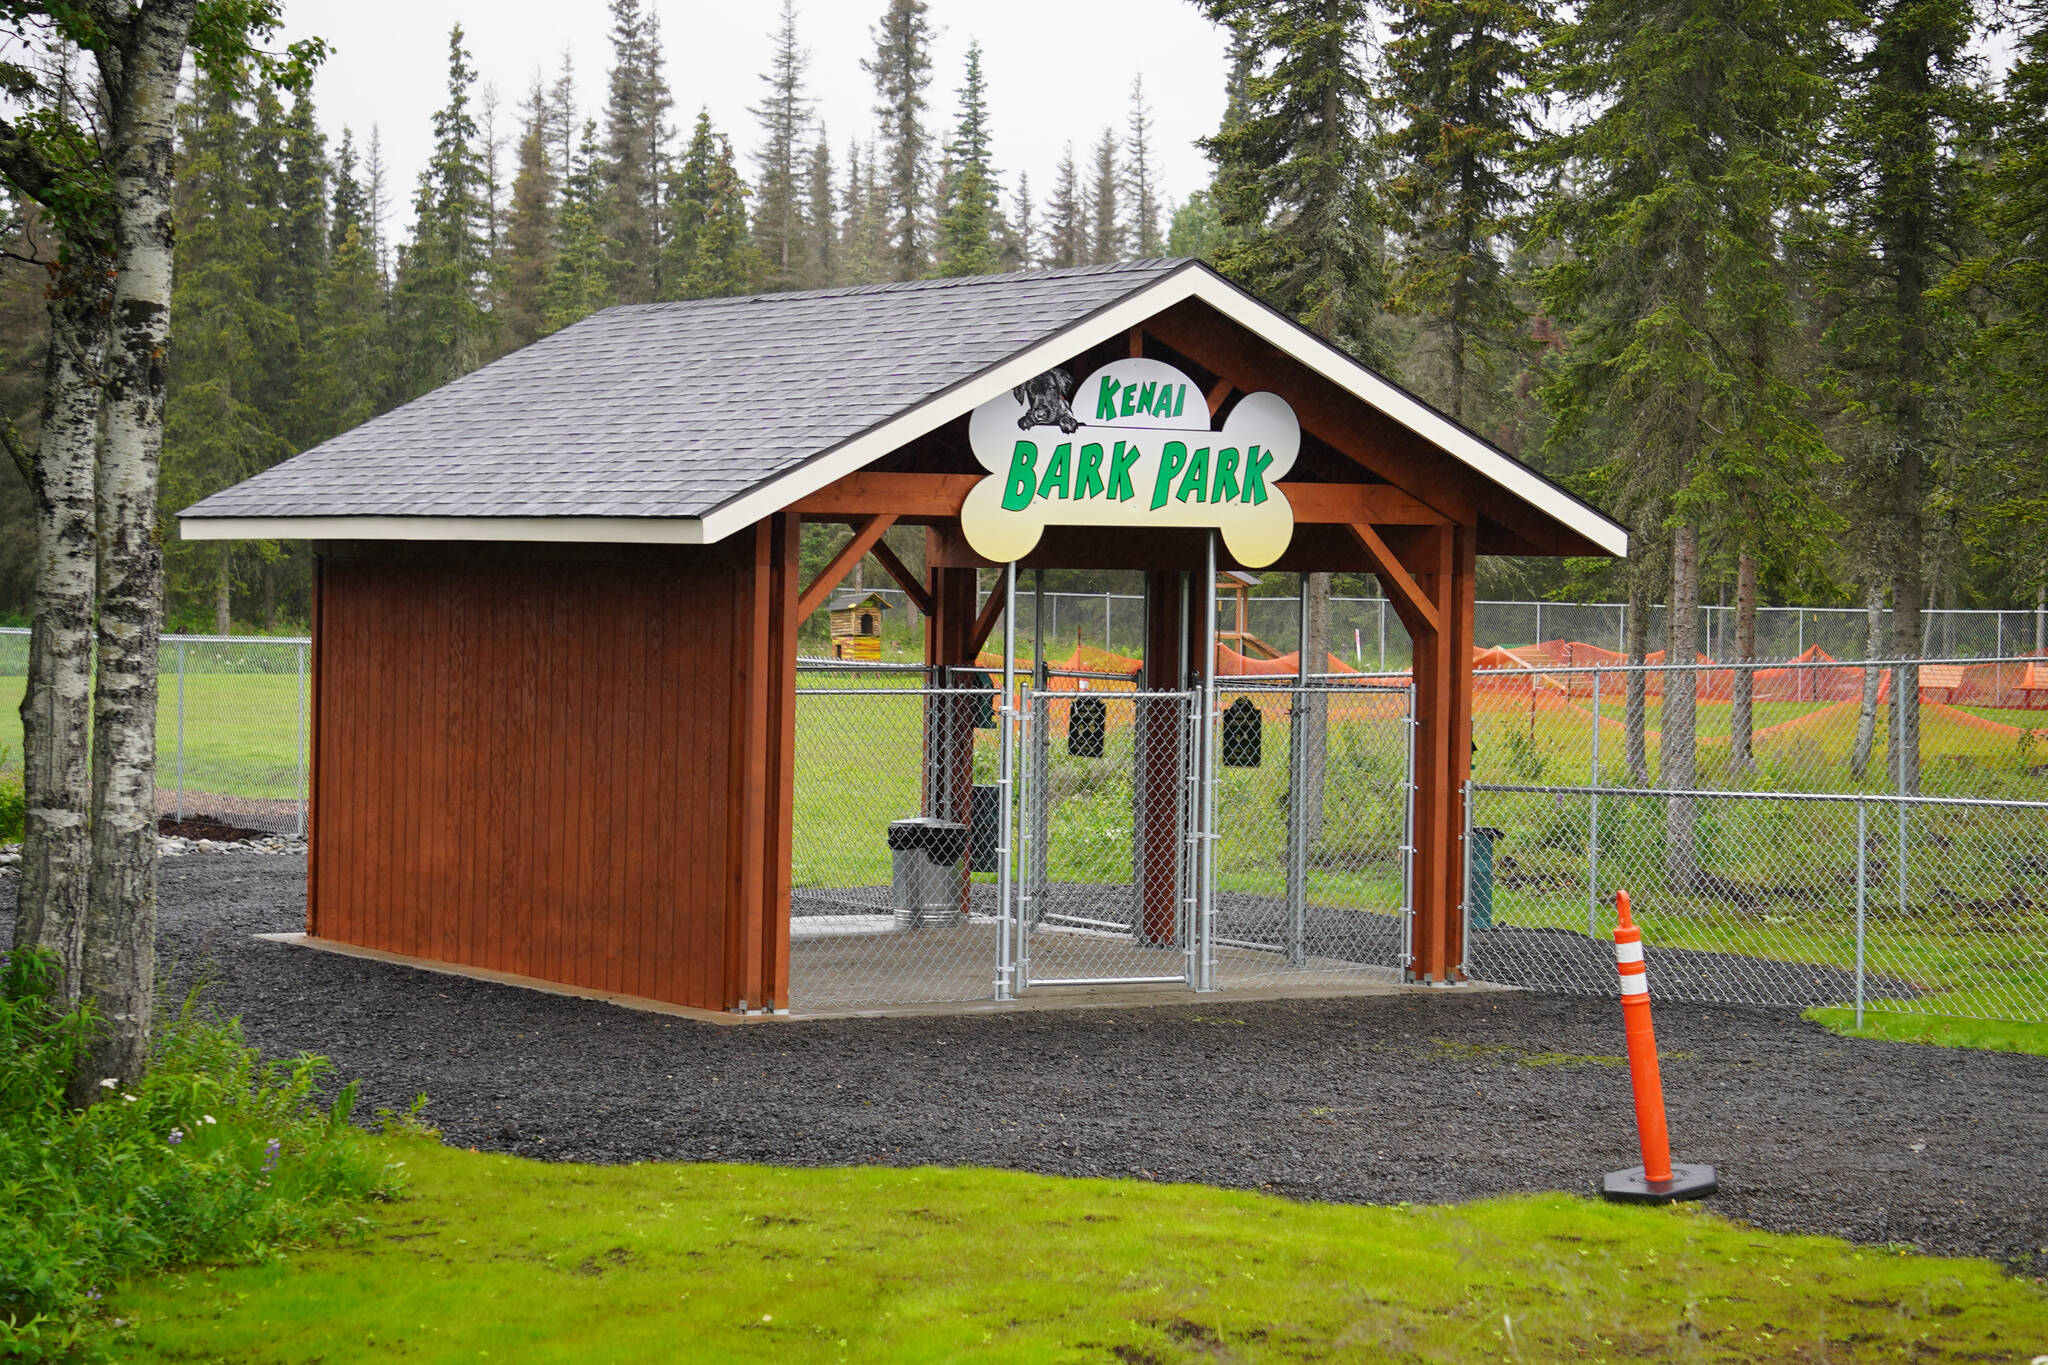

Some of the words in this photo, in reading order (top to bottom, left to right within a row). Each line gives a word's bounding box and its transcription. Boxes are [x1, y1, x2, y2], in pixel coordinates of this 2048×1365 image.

[1096, 375, 1187, 421] KENAI
[1001, 440, 1141, 512] BARK
[1149, 441, 1274, 512] PARK
